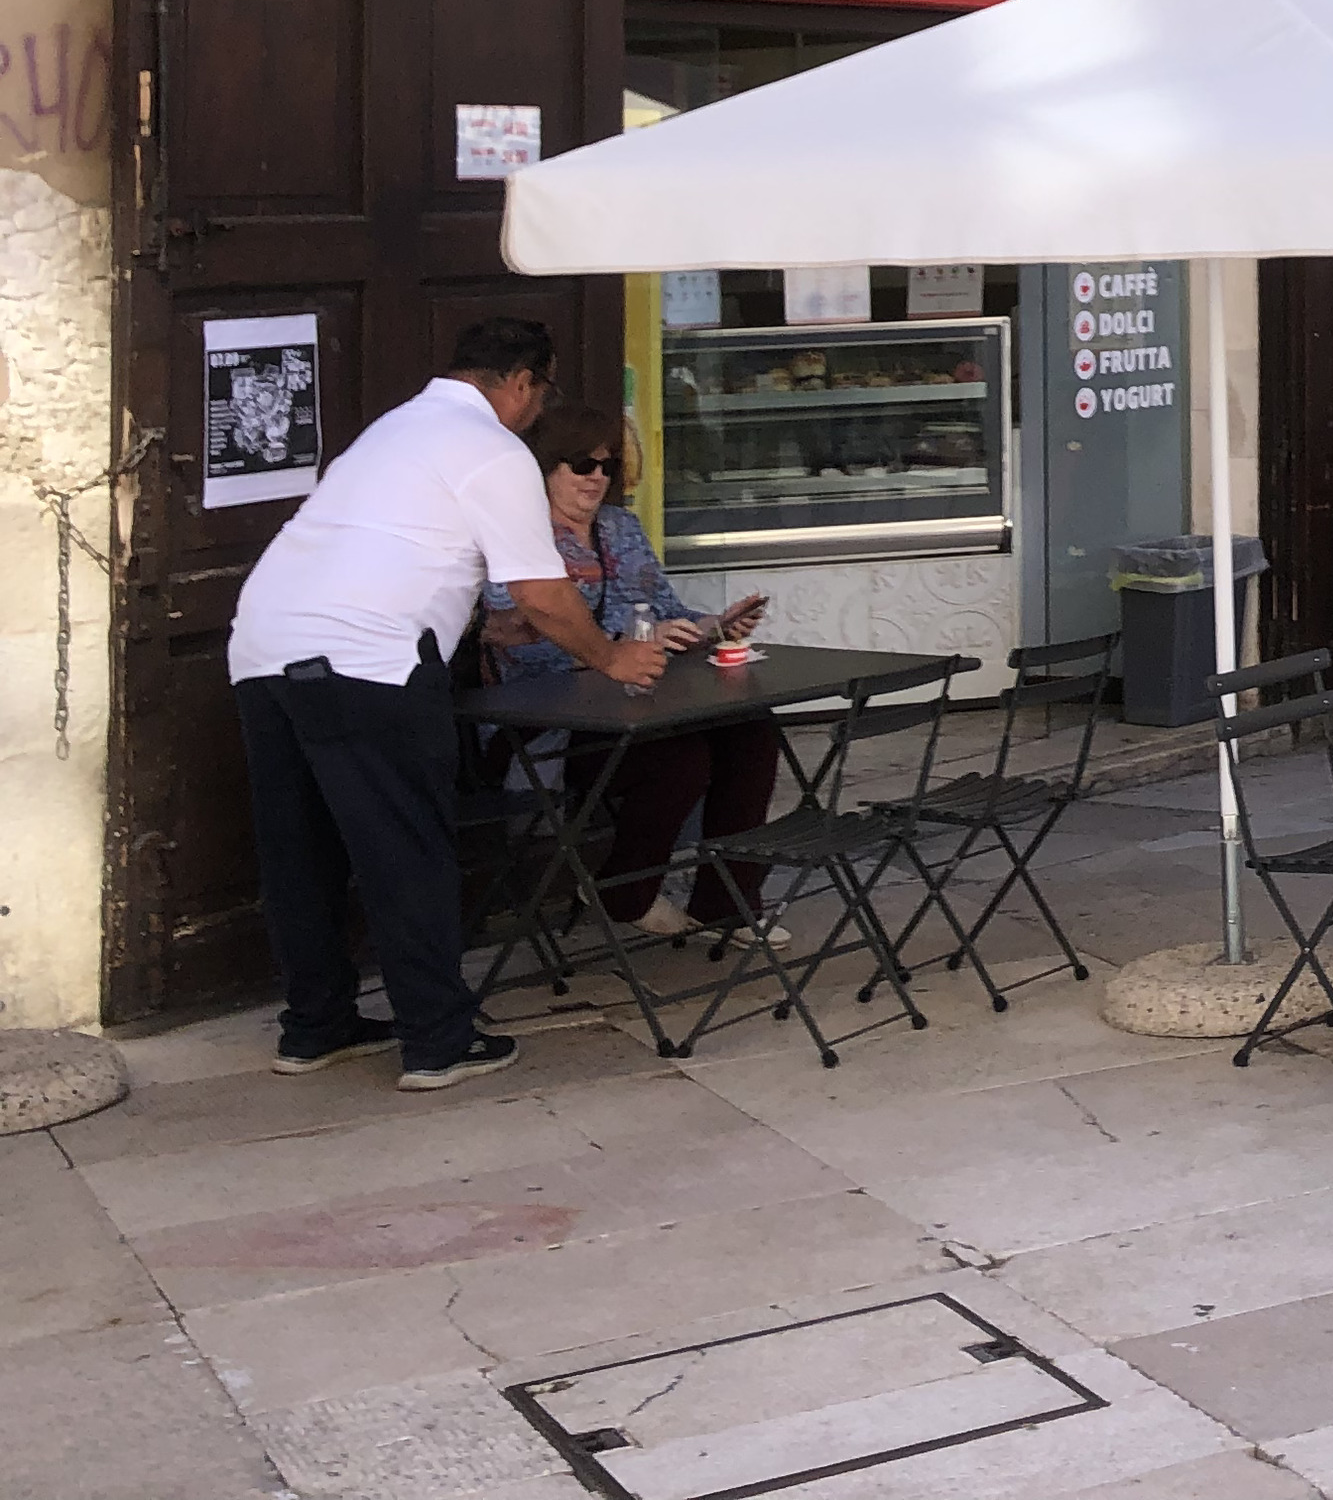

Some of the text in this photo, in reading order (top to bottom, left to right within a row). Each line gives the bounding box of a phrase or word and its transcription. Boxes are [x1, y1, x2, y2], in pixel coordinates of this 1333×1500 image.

[1098, 266, 1159, 298] CAFFÈ
[1099, 309, 1155, 336] DOLCI
[1099, 346, 1172, 375] FRUTTA
[1100, 382, 1175, 412] YOGURT
